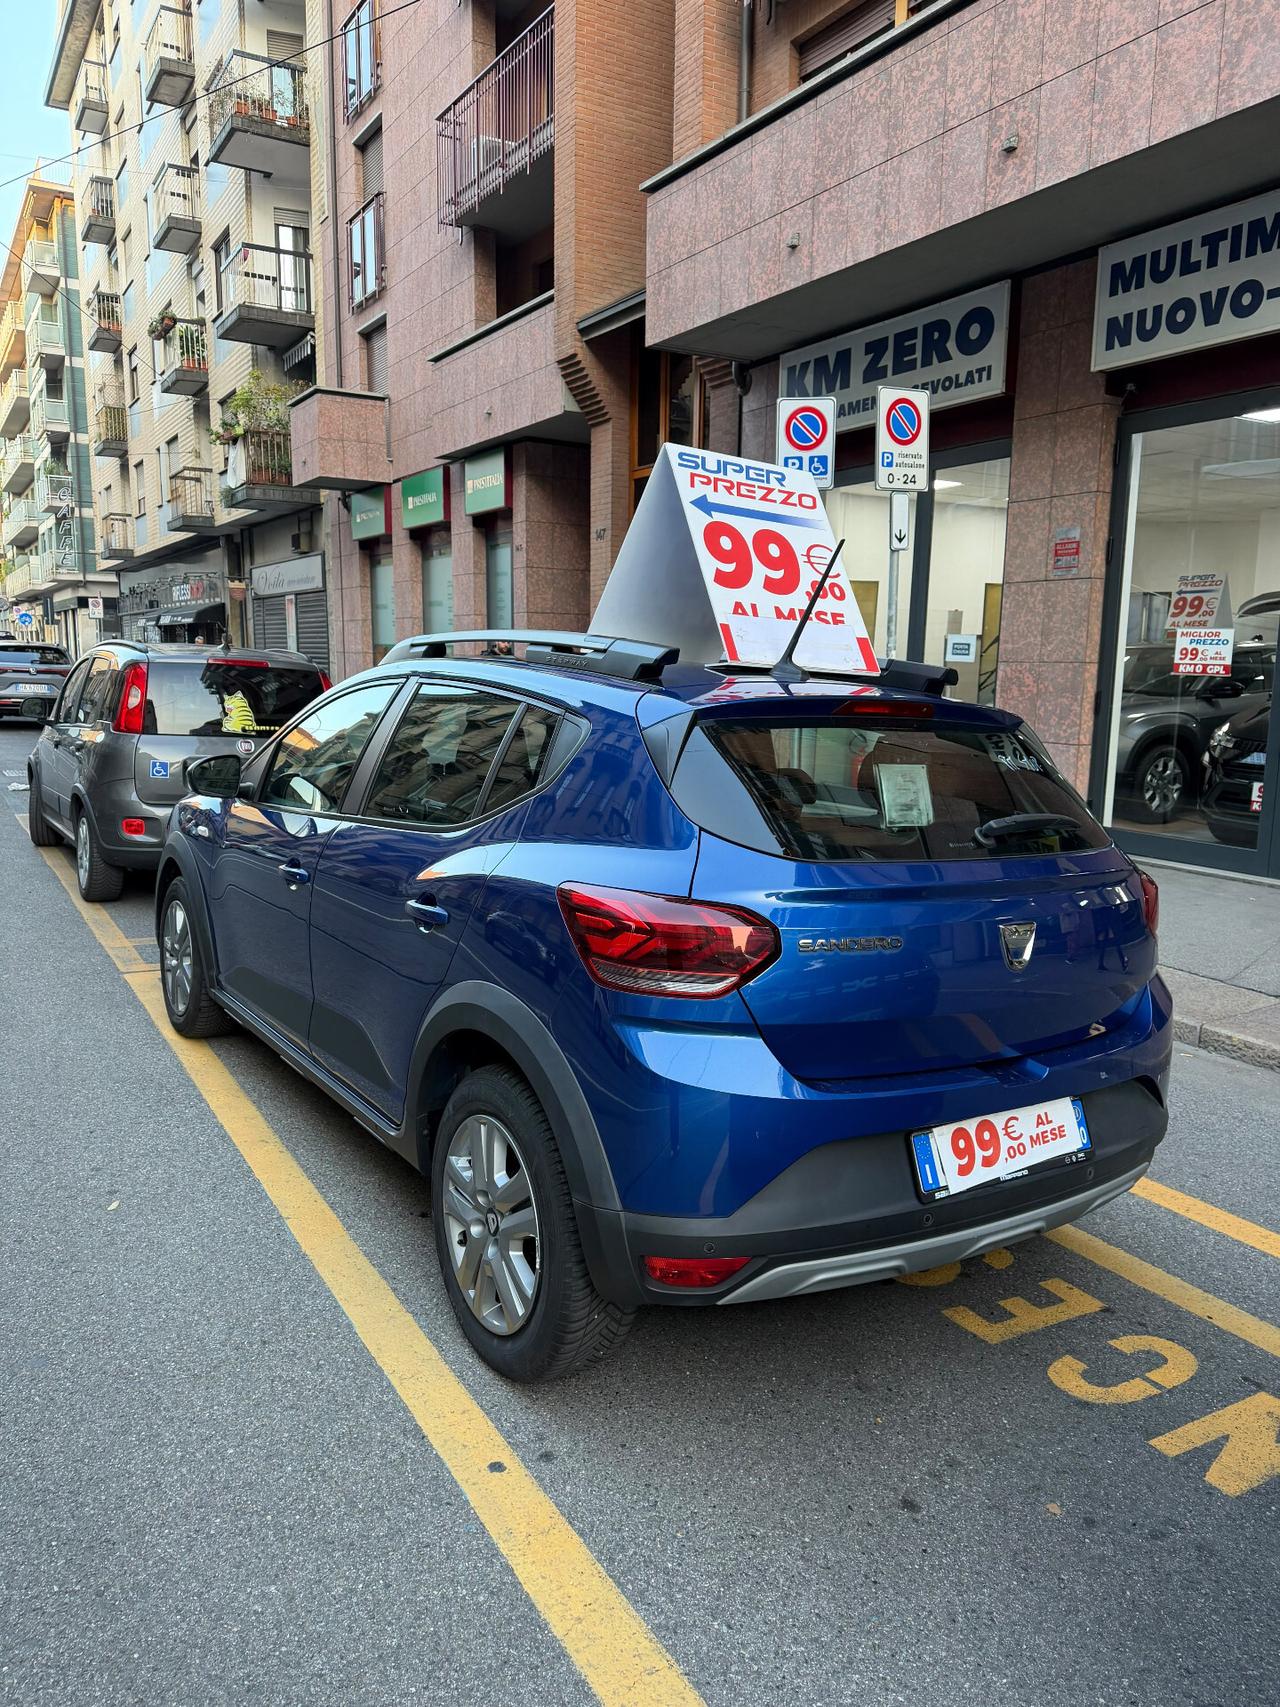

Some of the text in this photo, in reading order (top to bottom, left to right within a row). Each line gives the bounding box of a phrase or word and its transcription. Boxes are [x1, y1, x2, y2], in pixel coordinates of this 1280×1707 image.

[1109, 212, 1280, 297] MULTIM
[787, 306, 995, 397] KM ZERO
[898, 451, 923, 460] riservato
[677, 451, 786, 487] SUPER
[895, 460, 925, 470] autosalone
[689, 472, 817, 510] PREZZO
[703, 521, 801, 595] 99
[1178, 580, 1223, 588] PREZZO
[1170, 595, 1204, 618] 99
[1170, 620, 1181, 628] AL
[1180, 631, 1221, 639] MIGLIOR
[1189, 638, 1229, 646] PREZZO
[1179, 647, 1199, 661] 99
[1206, 665, 1226, 674] GPL
[799, 936, 903, 952] SANDERO
[1035, 1111, 1053, 1128] AL
[1029, 1125, 1067, 1148] MESE
[951, 1119, 1002, 1177] 99
[1002, 1116, 1023, 1141] €
